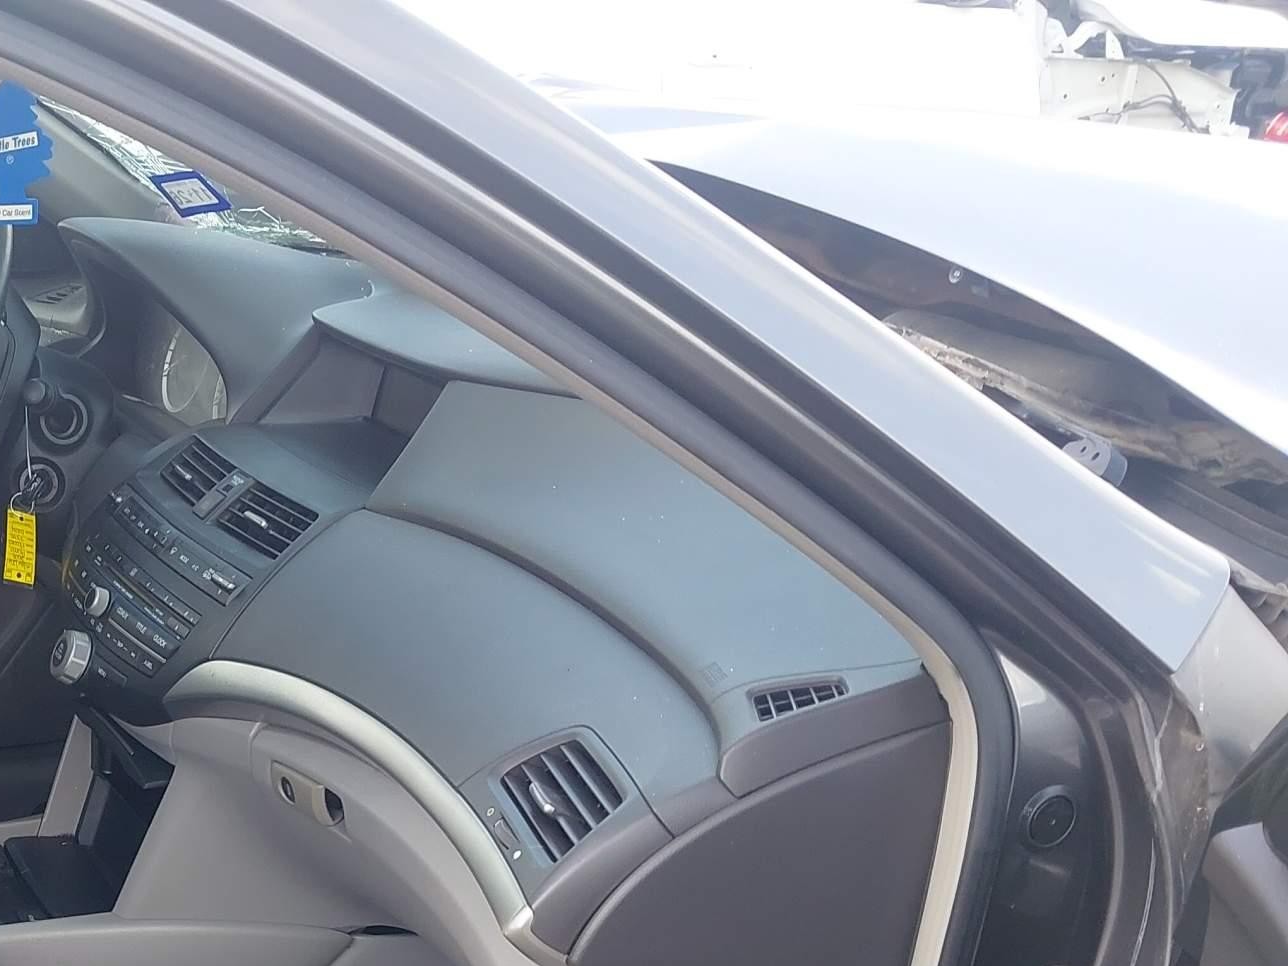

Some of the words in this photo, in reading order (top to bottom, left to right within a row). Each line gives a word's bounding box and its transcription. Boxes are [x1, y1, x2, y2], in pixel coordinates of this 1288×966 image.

[12, 135, 36, 148] Trees
[2, 208, 13, 217] Car
[153, 634, 167, 648] CLOCK
